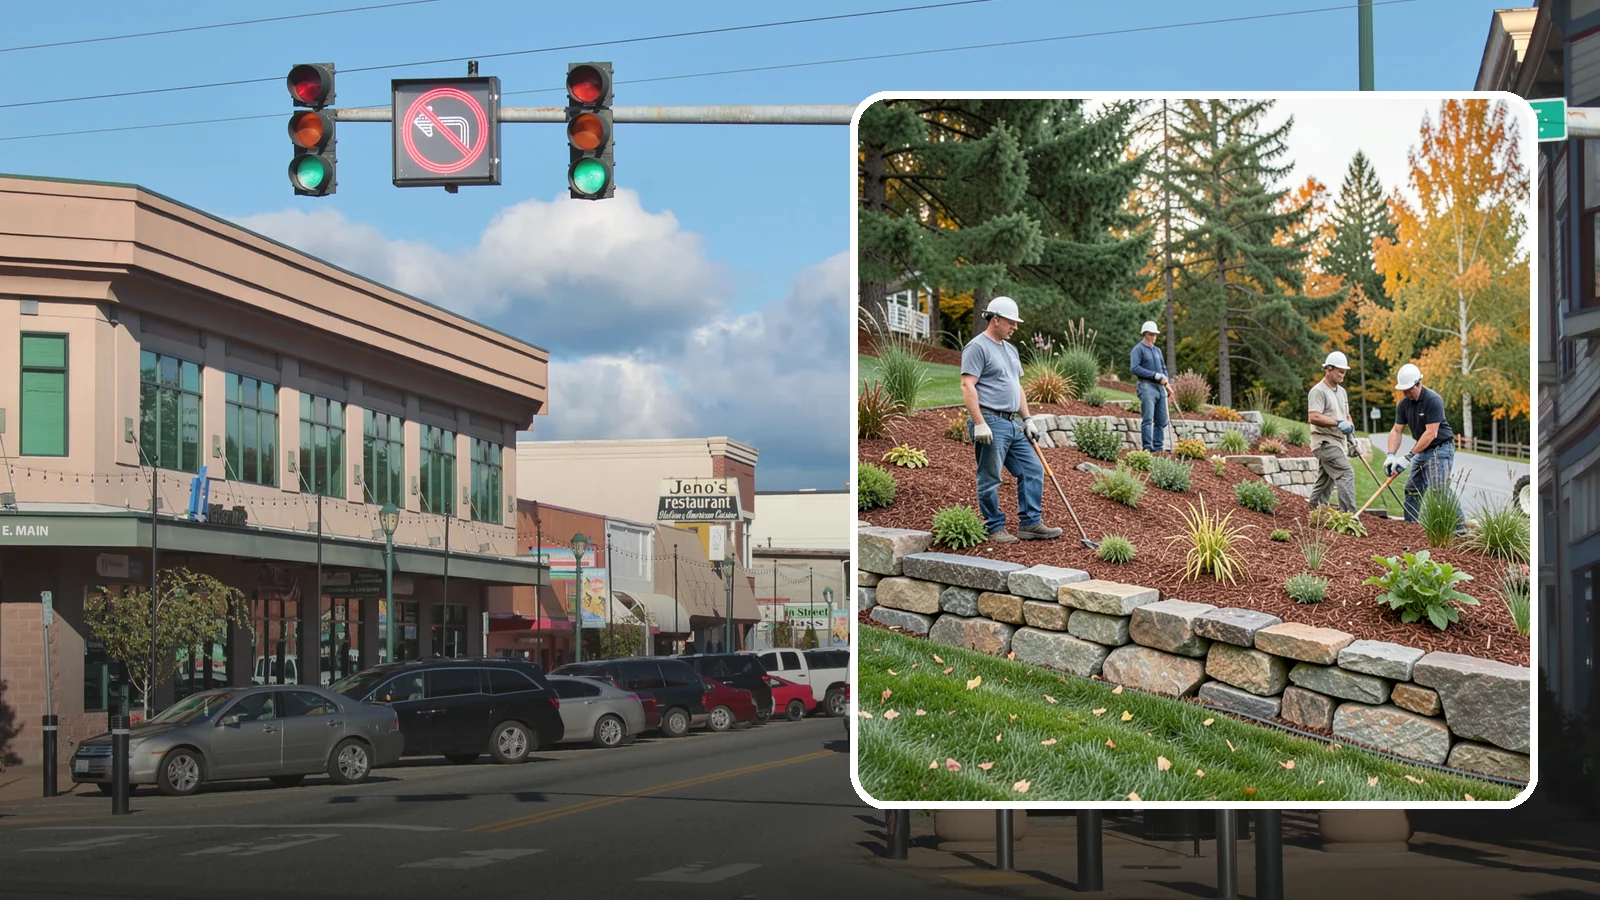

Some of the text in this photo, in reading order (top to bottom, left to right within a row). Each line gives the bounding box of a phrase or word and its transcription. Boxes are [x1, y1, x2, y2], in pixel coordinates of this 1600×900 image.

[670, 480, 727, 494] Jeno's
[665, 496, 731, 509] restaurant
[659, 509, 681, 519] Italian
[686, 509, 714, 519] American
[715, 509, 737, 519] Cuisine
[2, 525, 49, 536] E. MAIN
[797, 607, 828, 616] Street
